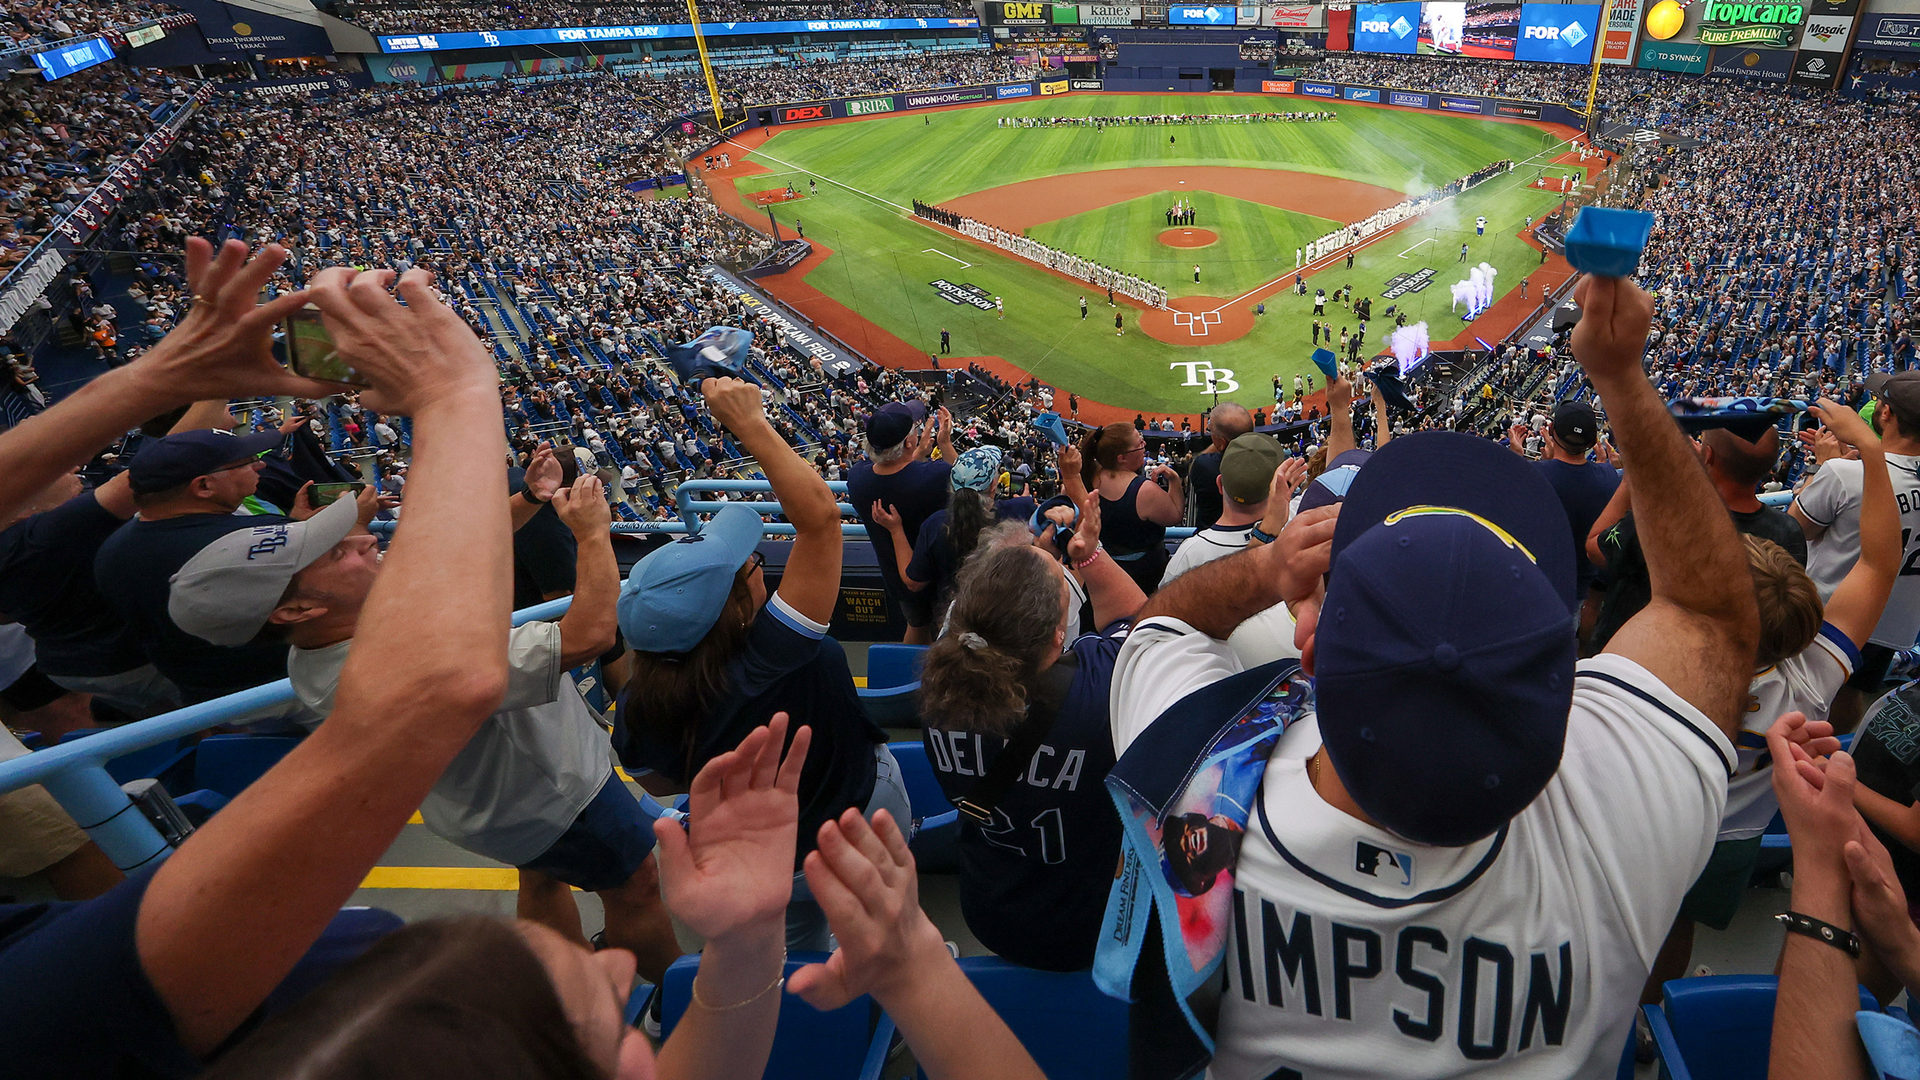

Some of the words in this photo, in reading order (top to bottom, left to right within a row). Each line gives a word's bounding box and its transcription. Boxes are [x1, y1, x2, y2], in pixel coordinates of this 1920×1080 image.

[1003, 2, 1043, 19] GMF
[1611, 0, 1637, 9] CARE
[1183, 9, 1204, 18] FOR
[1610, 10, 1636, 21] MADE
[1703, 0, 1803, 26] Tropicana
[808, 22, 829, 30] FOR
[829, 21, 862, 30] TAMPA
[1360, 21, 1390, 33] FOR
[1807, 24, 1847, 35] Mosaic
[478, 31, 500, 47] TB
[557, 29, 588, 40] FOR
[587, 27, 634, 38] TAMPA
[634, 26, 659, 36] BAY
[1524, 26, 1560, 40] FOR
[1701, 30, 1730, 42] PURE
[1729, 29, 1782, 41] PREMIUM
[206, 37, 233, 45] DREAM
[233, 35, 262, 44] FINDERS
[234, 42, 267, 50] TERRACE
[1658, 52, 1668, 60] TD
[1669, 54, 1702, 63] SYNNEX
[388, 65, 418, 78] VIVA
[1712, 65, 1735, 75] DREAM
[1735, 67, 1761, 77] FINDERS
[1761, 70, 1786, 79] HOMES
[255, 84, 301, 97] SOMOS
[300, 81, 330, 95] RAYS
[999, 87, 1027, 96] Spectrum
[1394, 94, 1423, 103] LECOM
[786, 106, 824, 121] DEX
[1382, 268, 1436, 299] POSTSEASON
[931, 279, 996, 310] POSTSEASON
[711, 272, 745, 296] WELCOME
[738, 293, 763, 308] BACK
[754, 305, 772, 315] TO
[767, 312, 813, 345] TROPICANA
[805, 340, 837, 362] FIELD
[1169, 360, 1240, 395] TB
[845, 597, 881, 607] WATCH
[855, 606, 874, 614] OUT
[1113, 897, 1127, 943] DREAM
[1232, 886, 1574, 1061] IMPSON
